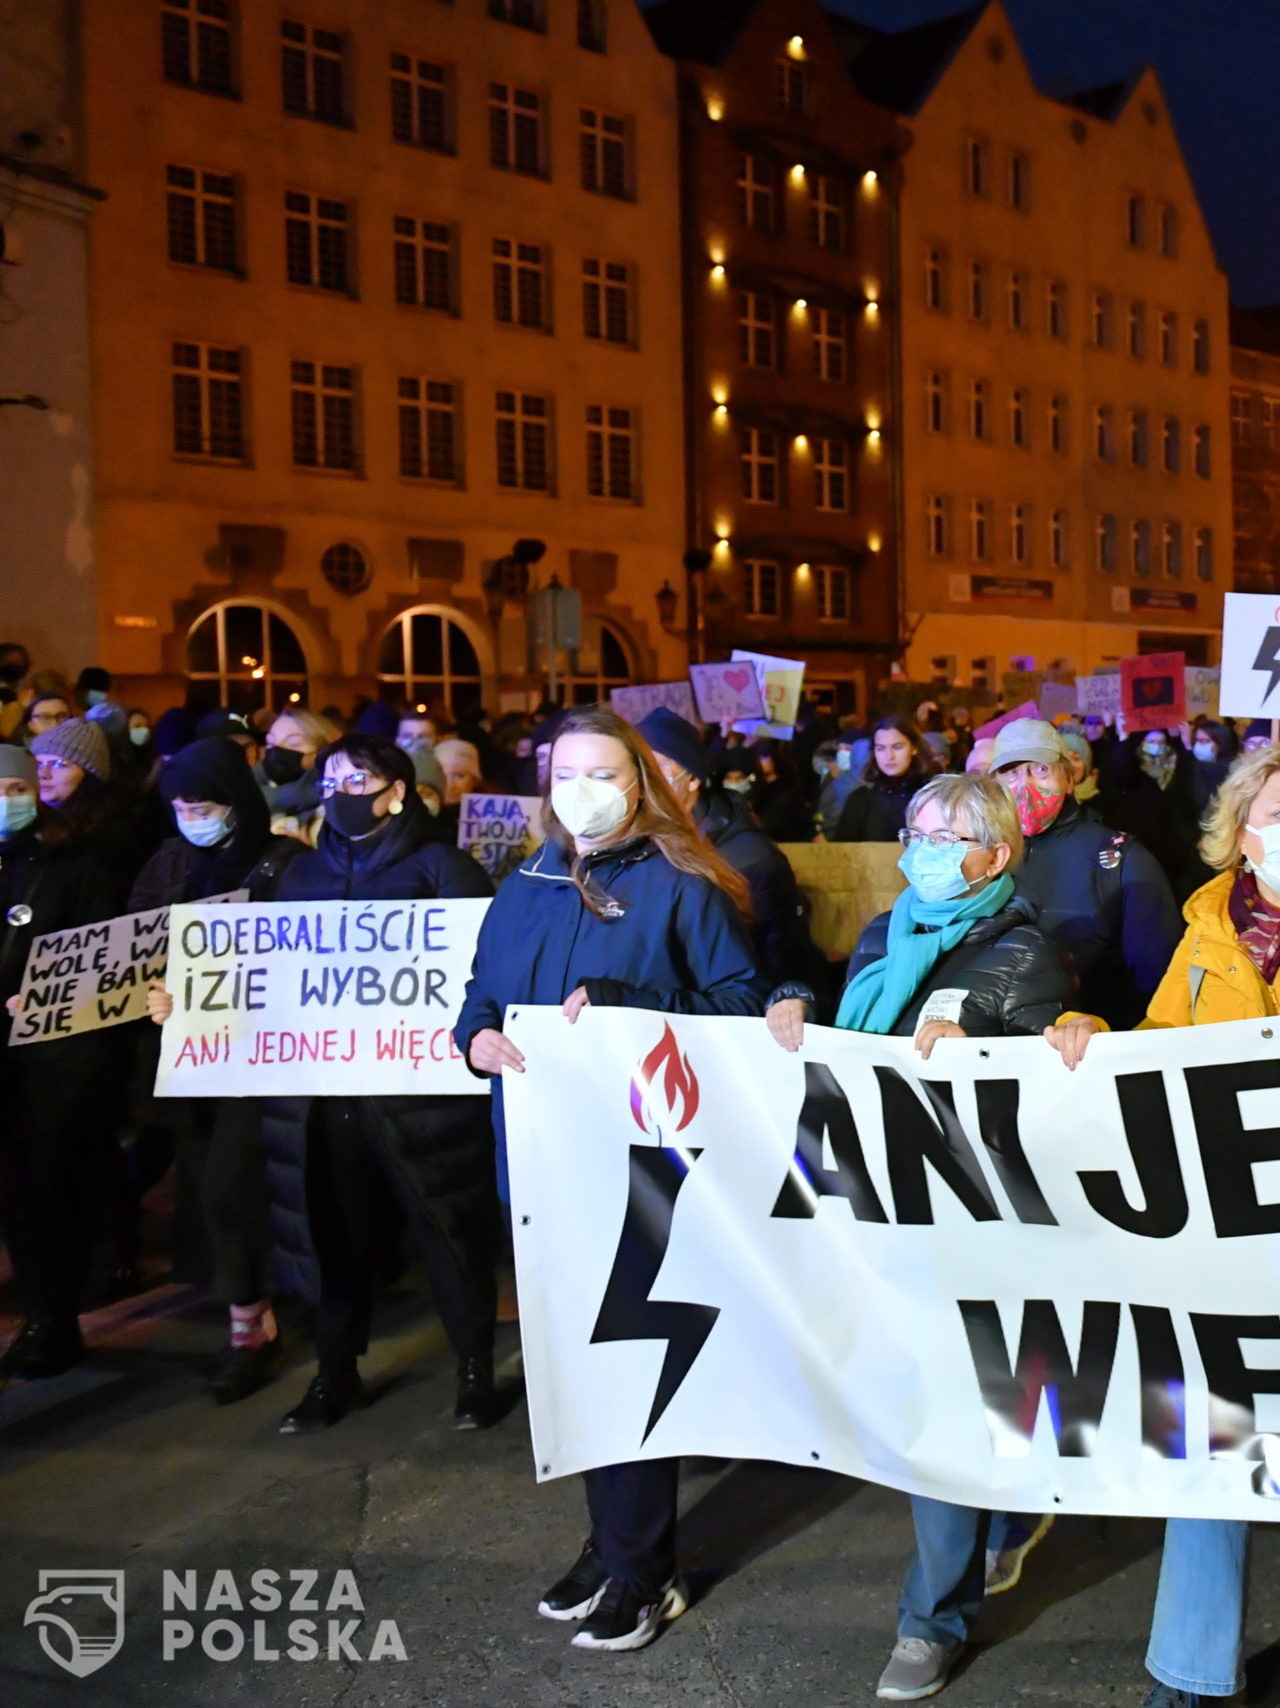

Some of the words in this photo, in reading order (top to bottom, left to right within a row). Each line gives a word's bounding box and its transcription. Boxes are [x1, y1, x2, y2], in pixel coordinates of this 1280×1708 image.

[36, 925, 110, 959] MAM
[23, 978, 79, 1012] NIE
[300, 955, 448, 1009] WYBÓR
[16, 1006, 73, 1038] SIĘ
[248, 1028, 356, 1065] JEDNEJ
[769, 1061, 1059, 1226] ANI
